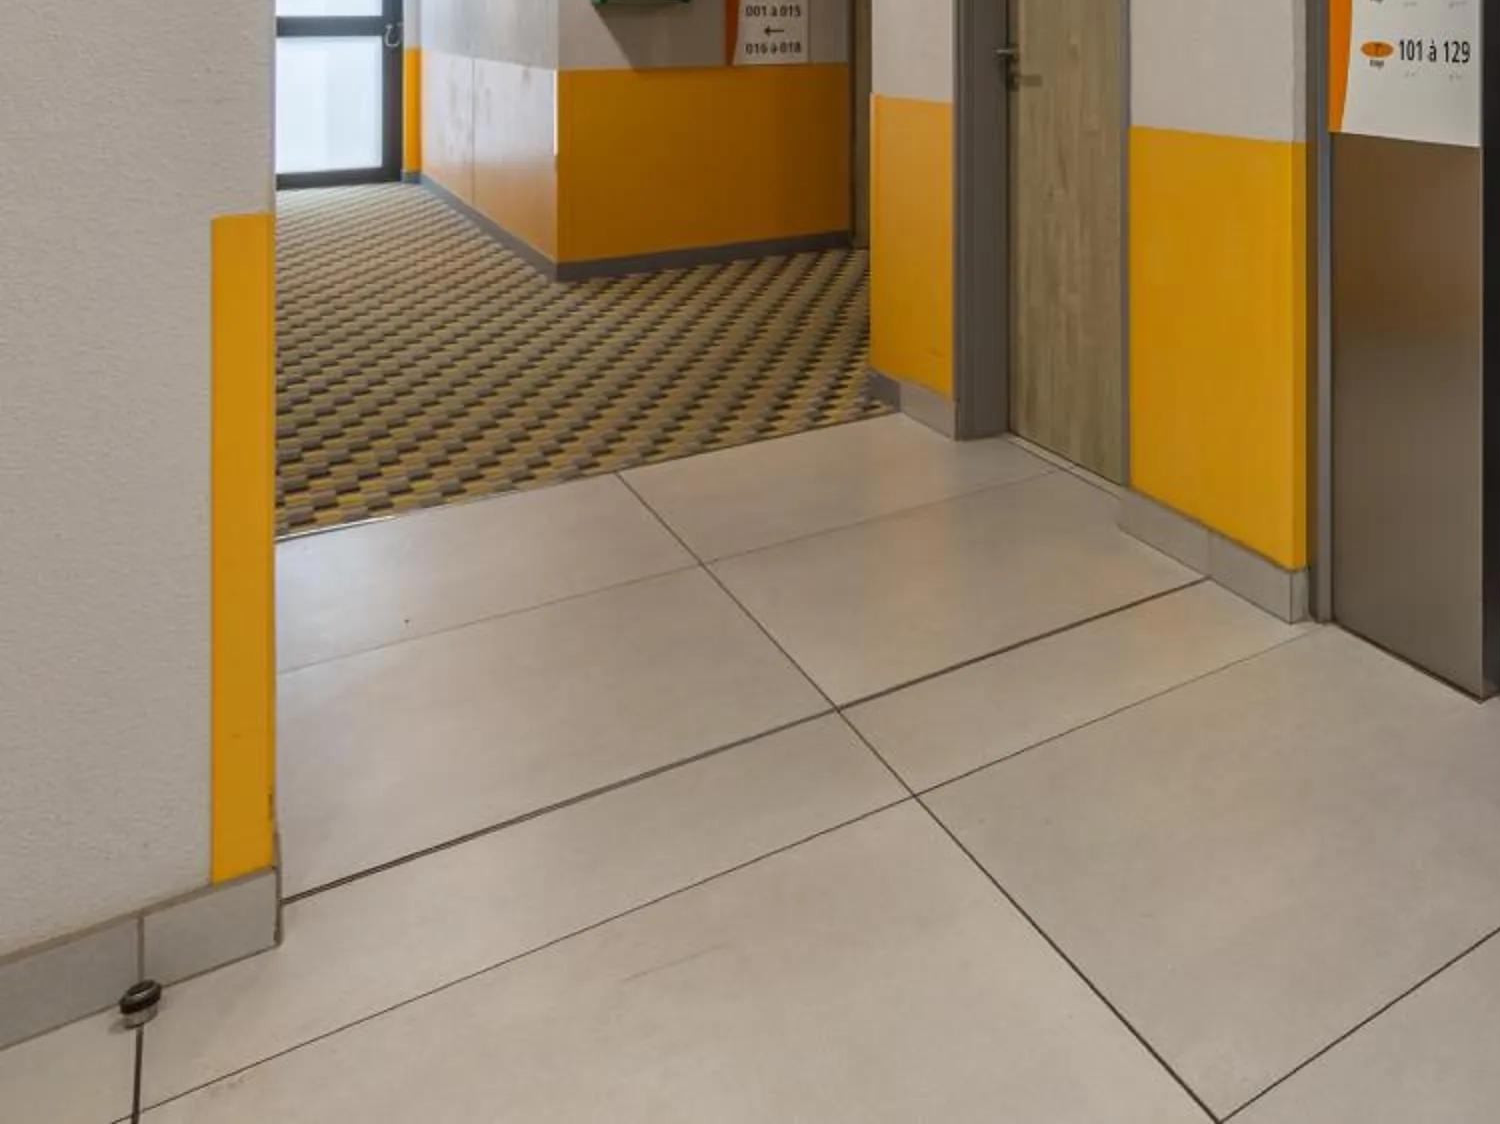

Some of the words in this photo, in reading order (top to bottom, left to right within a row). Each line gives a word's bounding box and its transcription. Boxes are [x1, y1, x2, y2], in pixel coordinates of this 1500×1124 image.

[745, 5, 767, 17] 001
[1399, 39, 1423, 62] 101
[1428, 39, 1438, 63] à
[1443, 40, 1471, 64] 129
